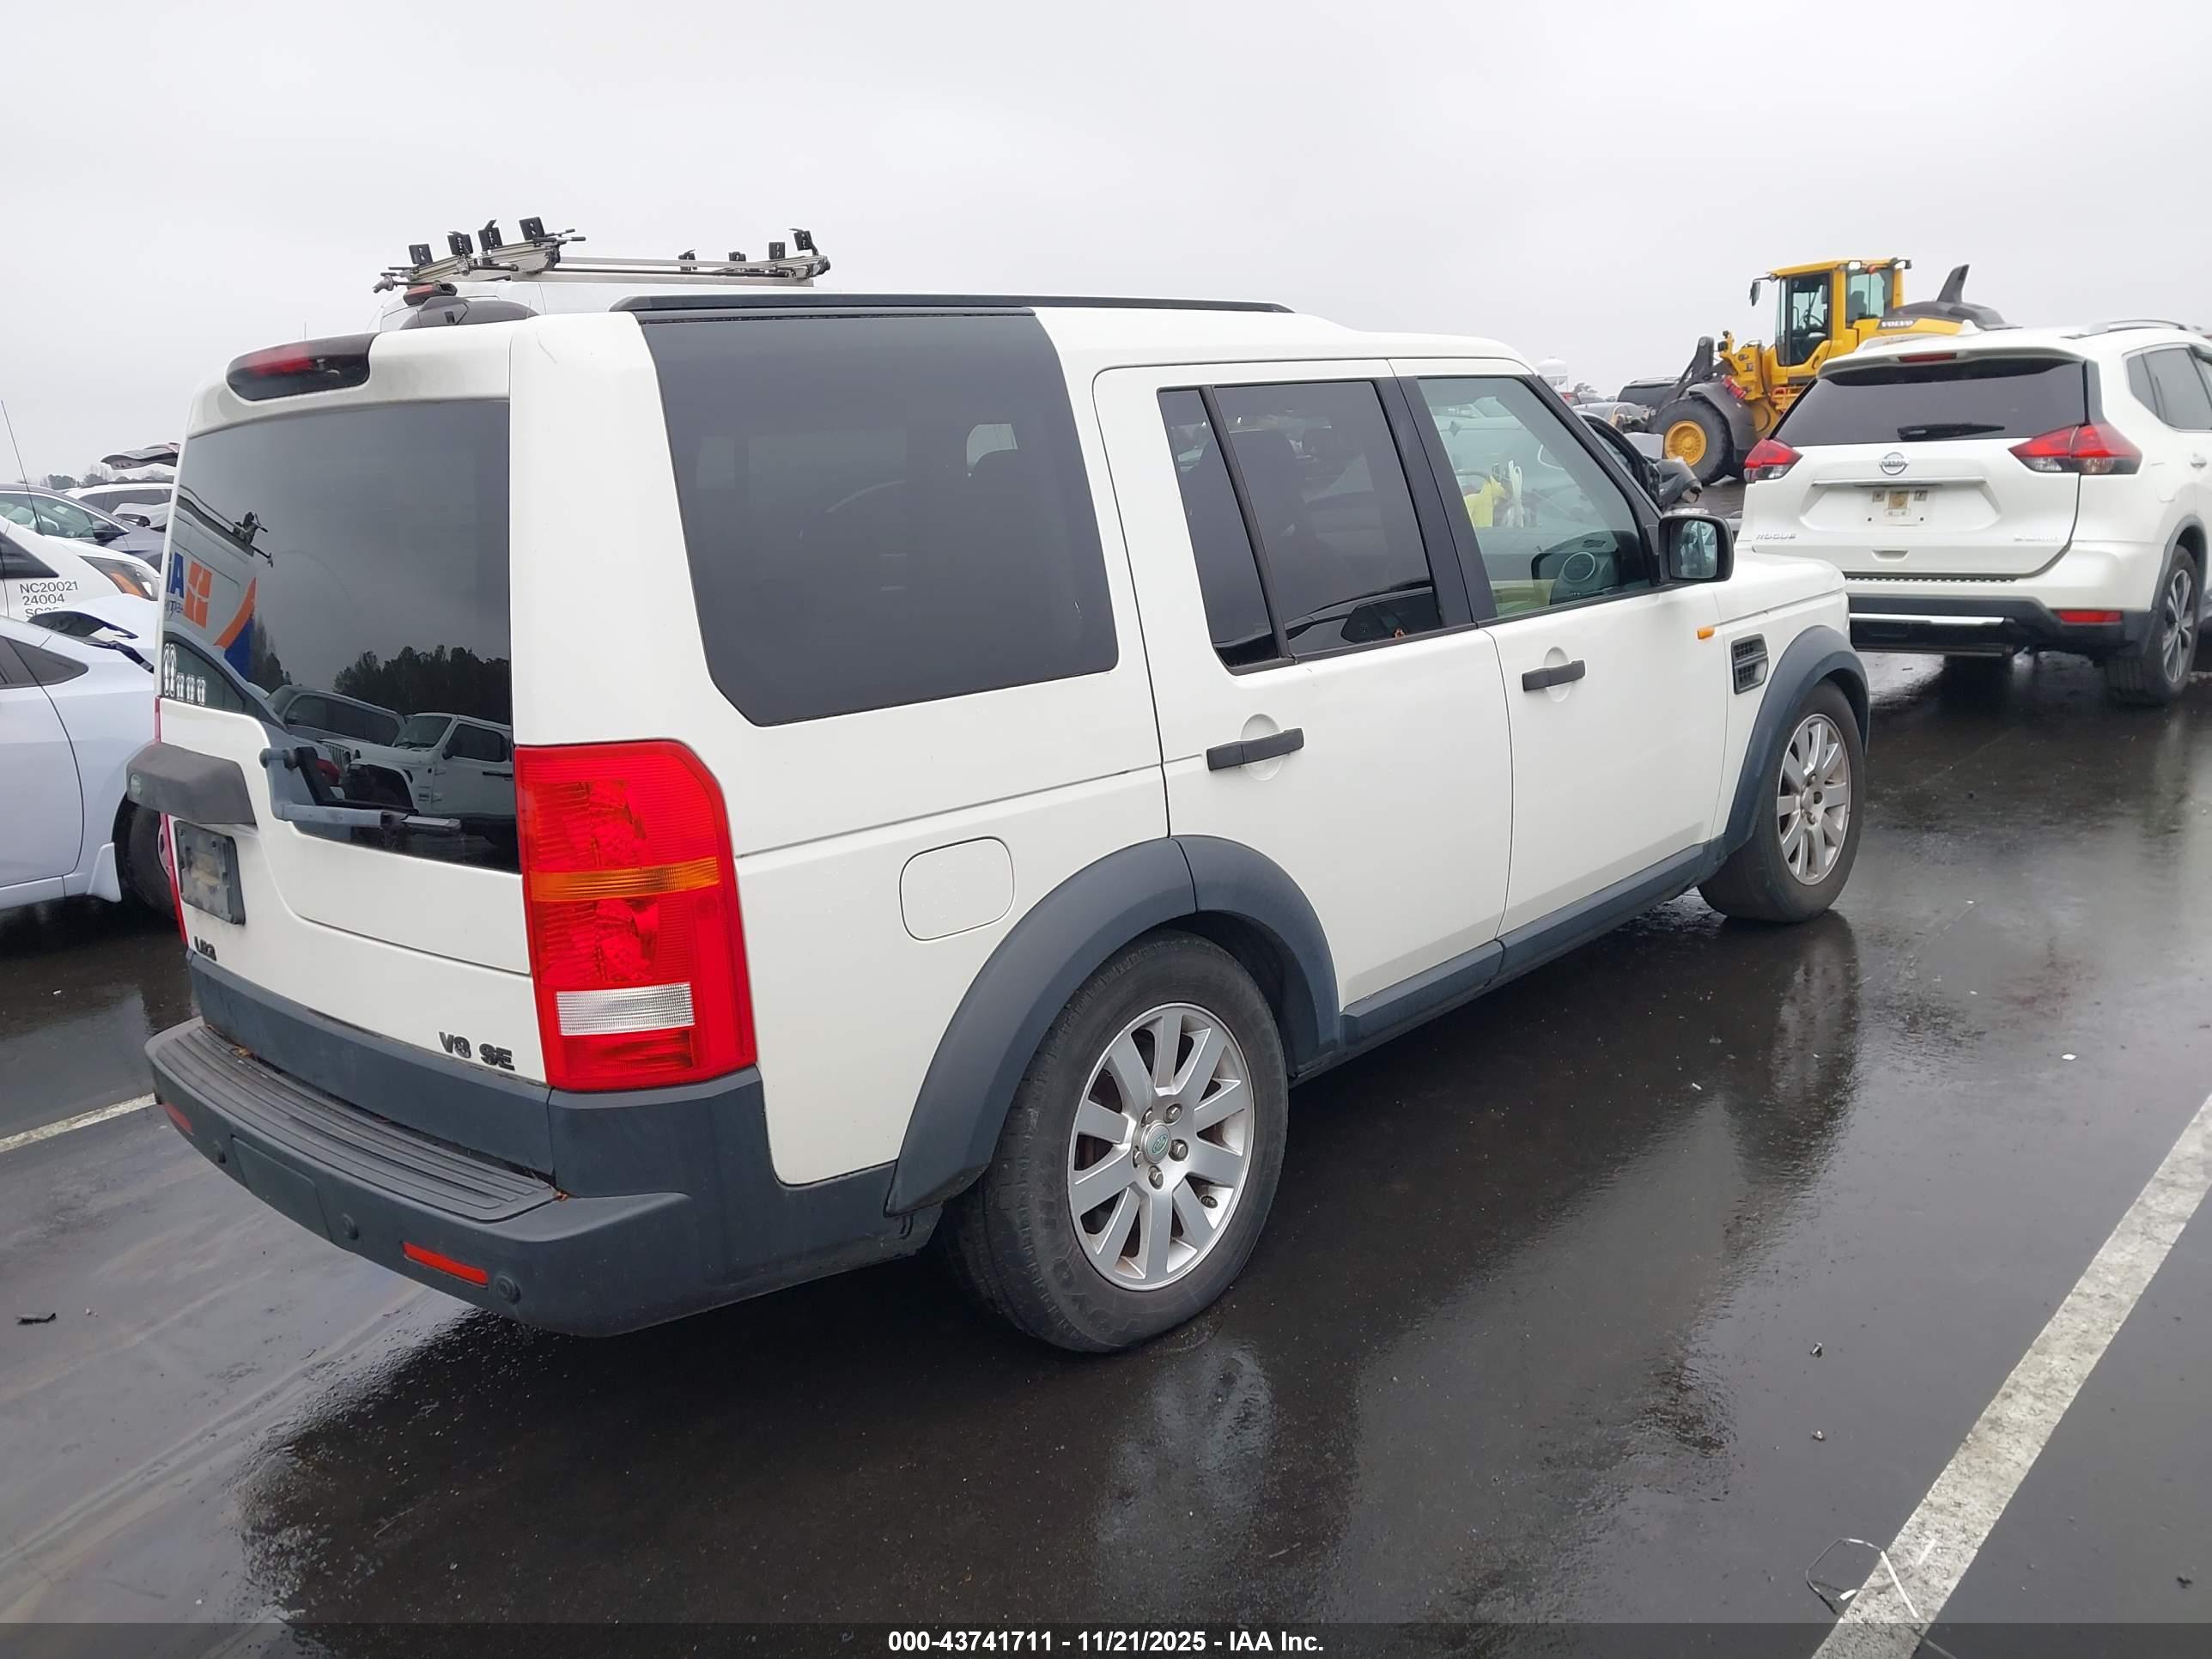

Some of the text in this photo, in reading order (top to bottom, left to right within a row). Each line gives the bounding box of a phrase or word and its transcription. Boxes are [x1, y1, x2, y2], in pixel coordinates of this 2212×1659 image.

[19, 580, 78, 593] NC20021
[22, 593, 64, 605] 24004
[479, 1043, 515, 1071] SE
